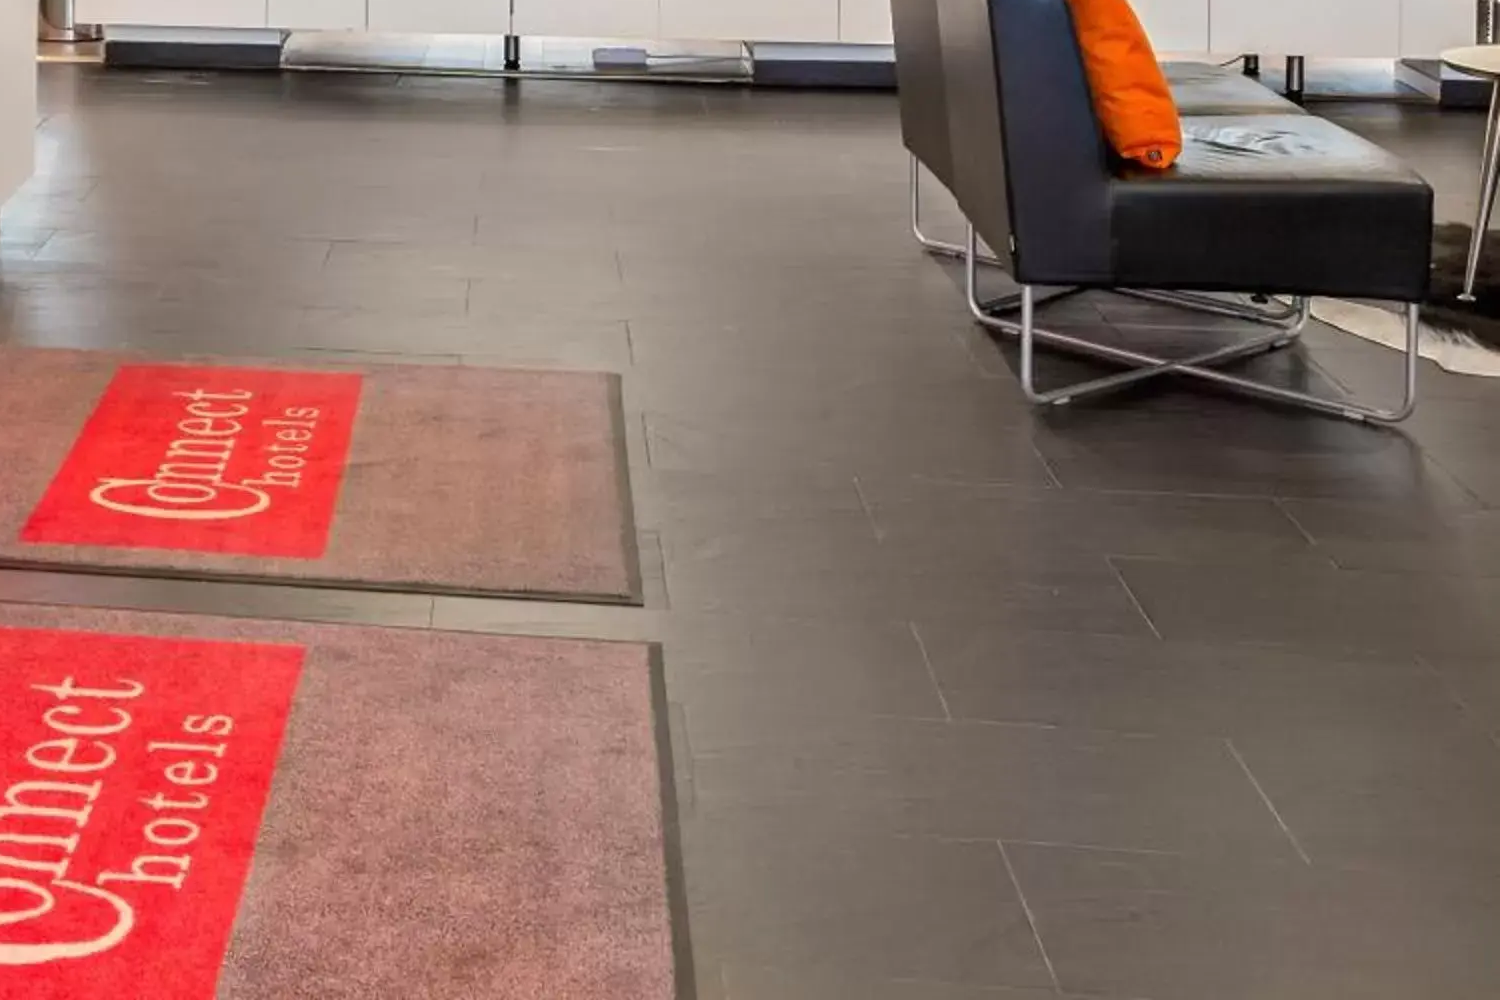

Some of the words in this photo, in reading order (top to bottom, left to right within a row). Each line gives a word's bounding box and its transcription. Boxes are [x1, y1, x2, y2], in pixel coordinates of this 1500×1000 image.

[90, 388, 270, 520] Connect
[243, 405, 321, 487] hotels
[97, 713, 234, 890] hotels
